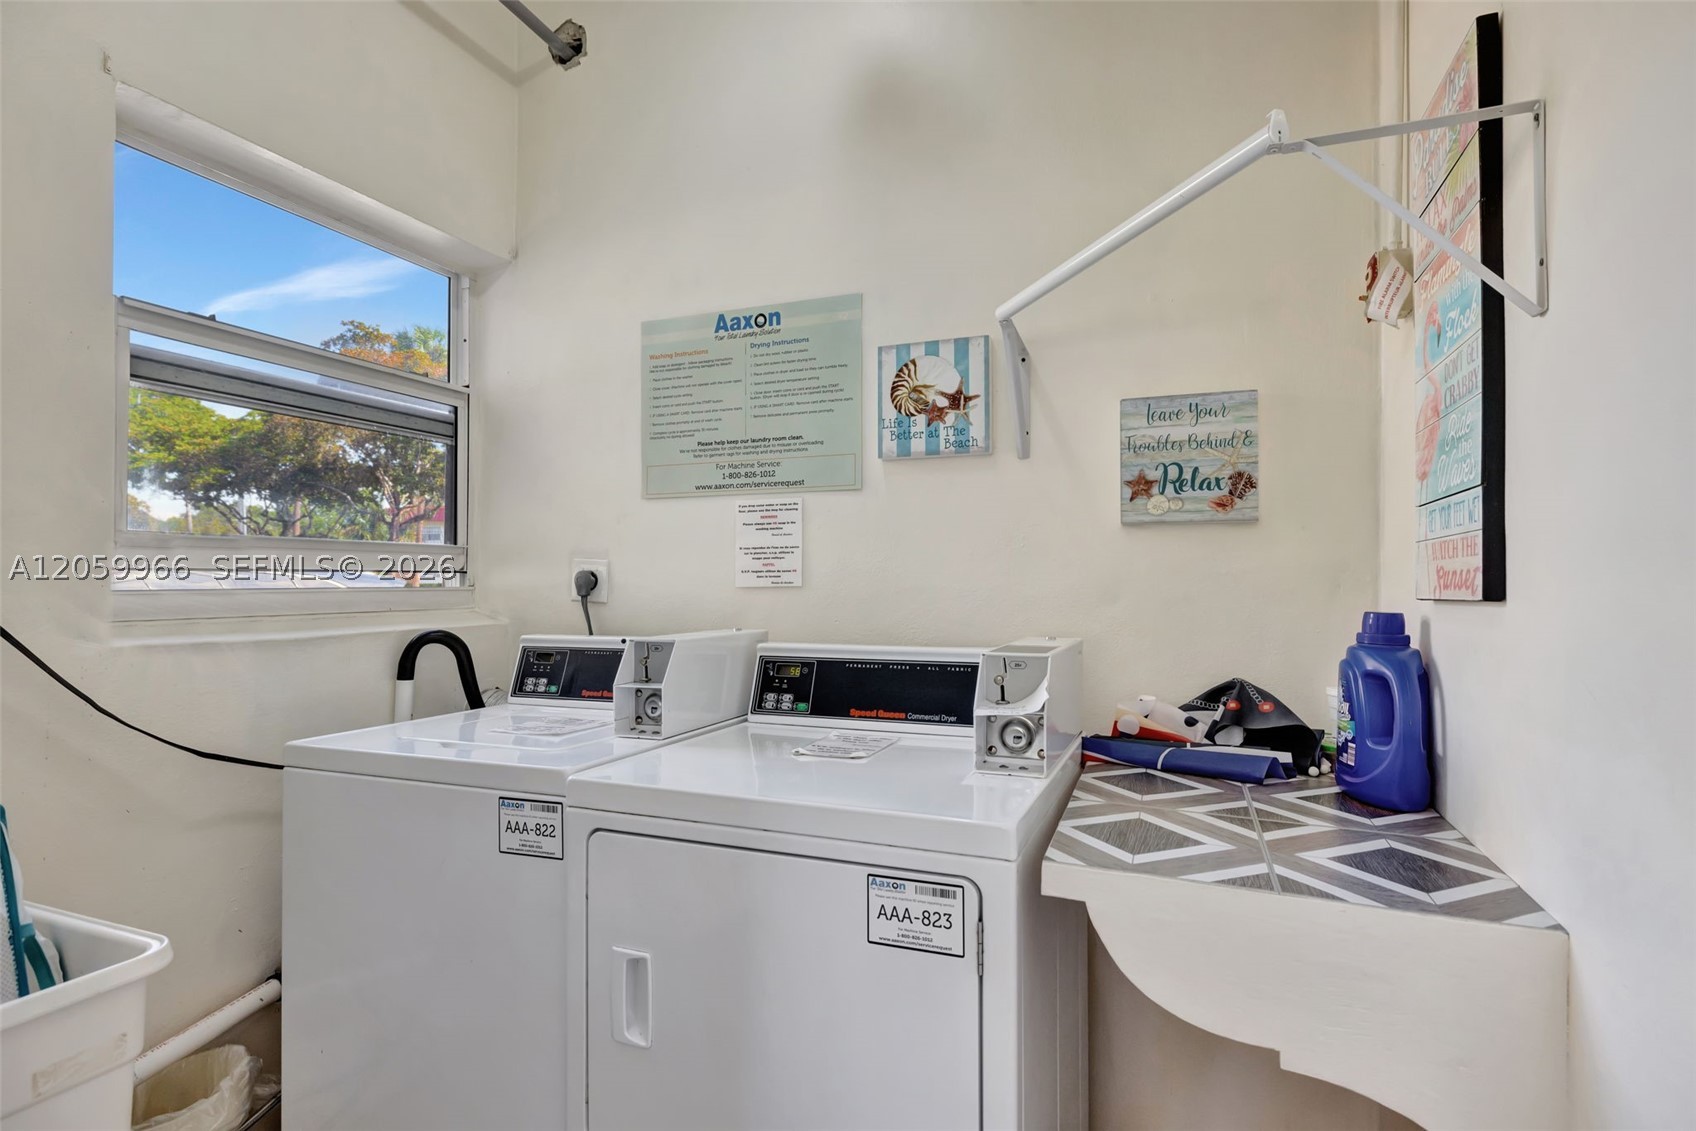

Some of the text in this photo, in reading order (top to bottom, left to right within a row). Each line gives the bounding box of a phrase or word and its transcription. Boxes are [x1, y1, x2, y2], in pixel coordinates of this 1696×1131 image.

[713, 311, 781, 333] Aaxon
[1443, 288, 1478, 353] Flock
[750, 336, 809, 350] Drying Instructions
[649, 348, 708, 360] Washing Instructions
[1444, 337, 1480, 383] DON'T GET
[1444, 366, 1480, 409] CRABBY
[882, 418, 917, 429] Life Is
[1189, 402, 1231, 427] Your
[890, 426, 966, 441] Better at The
[1445, 408, 1472, 450] Ride
[697, 439, 713, 447] Please
[750, 436, 771, 444] laundry
[944, 436, 979, 449] Beach
[1125, 434, 1183, 454] Troubles
[1187, 431, 1237, 450] Behind
[1458, 437, 1473, 457] the
[715, 460, 782, 470] For Machine Service:
[1438, 453, 1477, 492] Waves
[722, 470, 775, 479] 1-800-826-1012
[1155, 462, 1229, 495] Relax
[694, 478, 804, 490] www.aaxon.com/servicerequest
[1438, 504, 1452, 530] YOUR
[1454, 500, 1466, 527] FEET
[1468, 495, 1480, 525] WET
[1432, 535, 1479, 561] WATCH THE
[1434, 564, 1481, 598] Sunset
[581, 689, 603, 697] Speed
[849, 708, 957, 723] Speed Queen Commercial Dryer
[501, 800, 525, 809] Aaxon
[505, 820, 556, 838] AAA-822
[870, 877, 906, 890] Aaxon
[877, 904, 953, 930] AAA-823
[878, 936, 953, 951] www.aaxon.com/servicerequest
